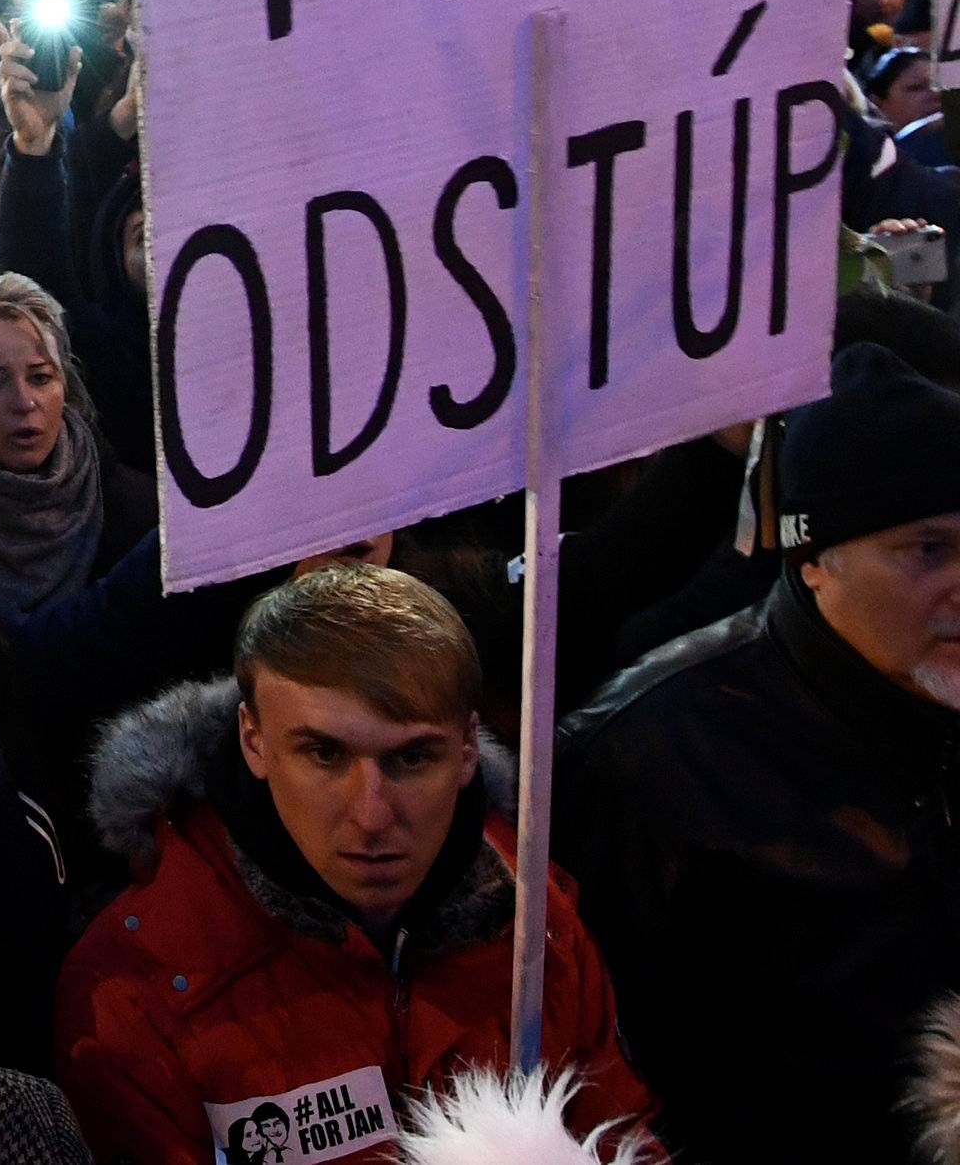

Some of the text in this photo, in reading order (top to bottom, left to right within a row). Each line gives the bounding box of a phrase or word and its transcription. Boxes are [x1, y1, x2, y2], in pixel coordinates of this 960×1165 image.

[158, 0, 842, 509] ODSTÚP
[293, 1084, 356, 1127] #ALL
[297, 1104, 385, 1156] FOR JAN
